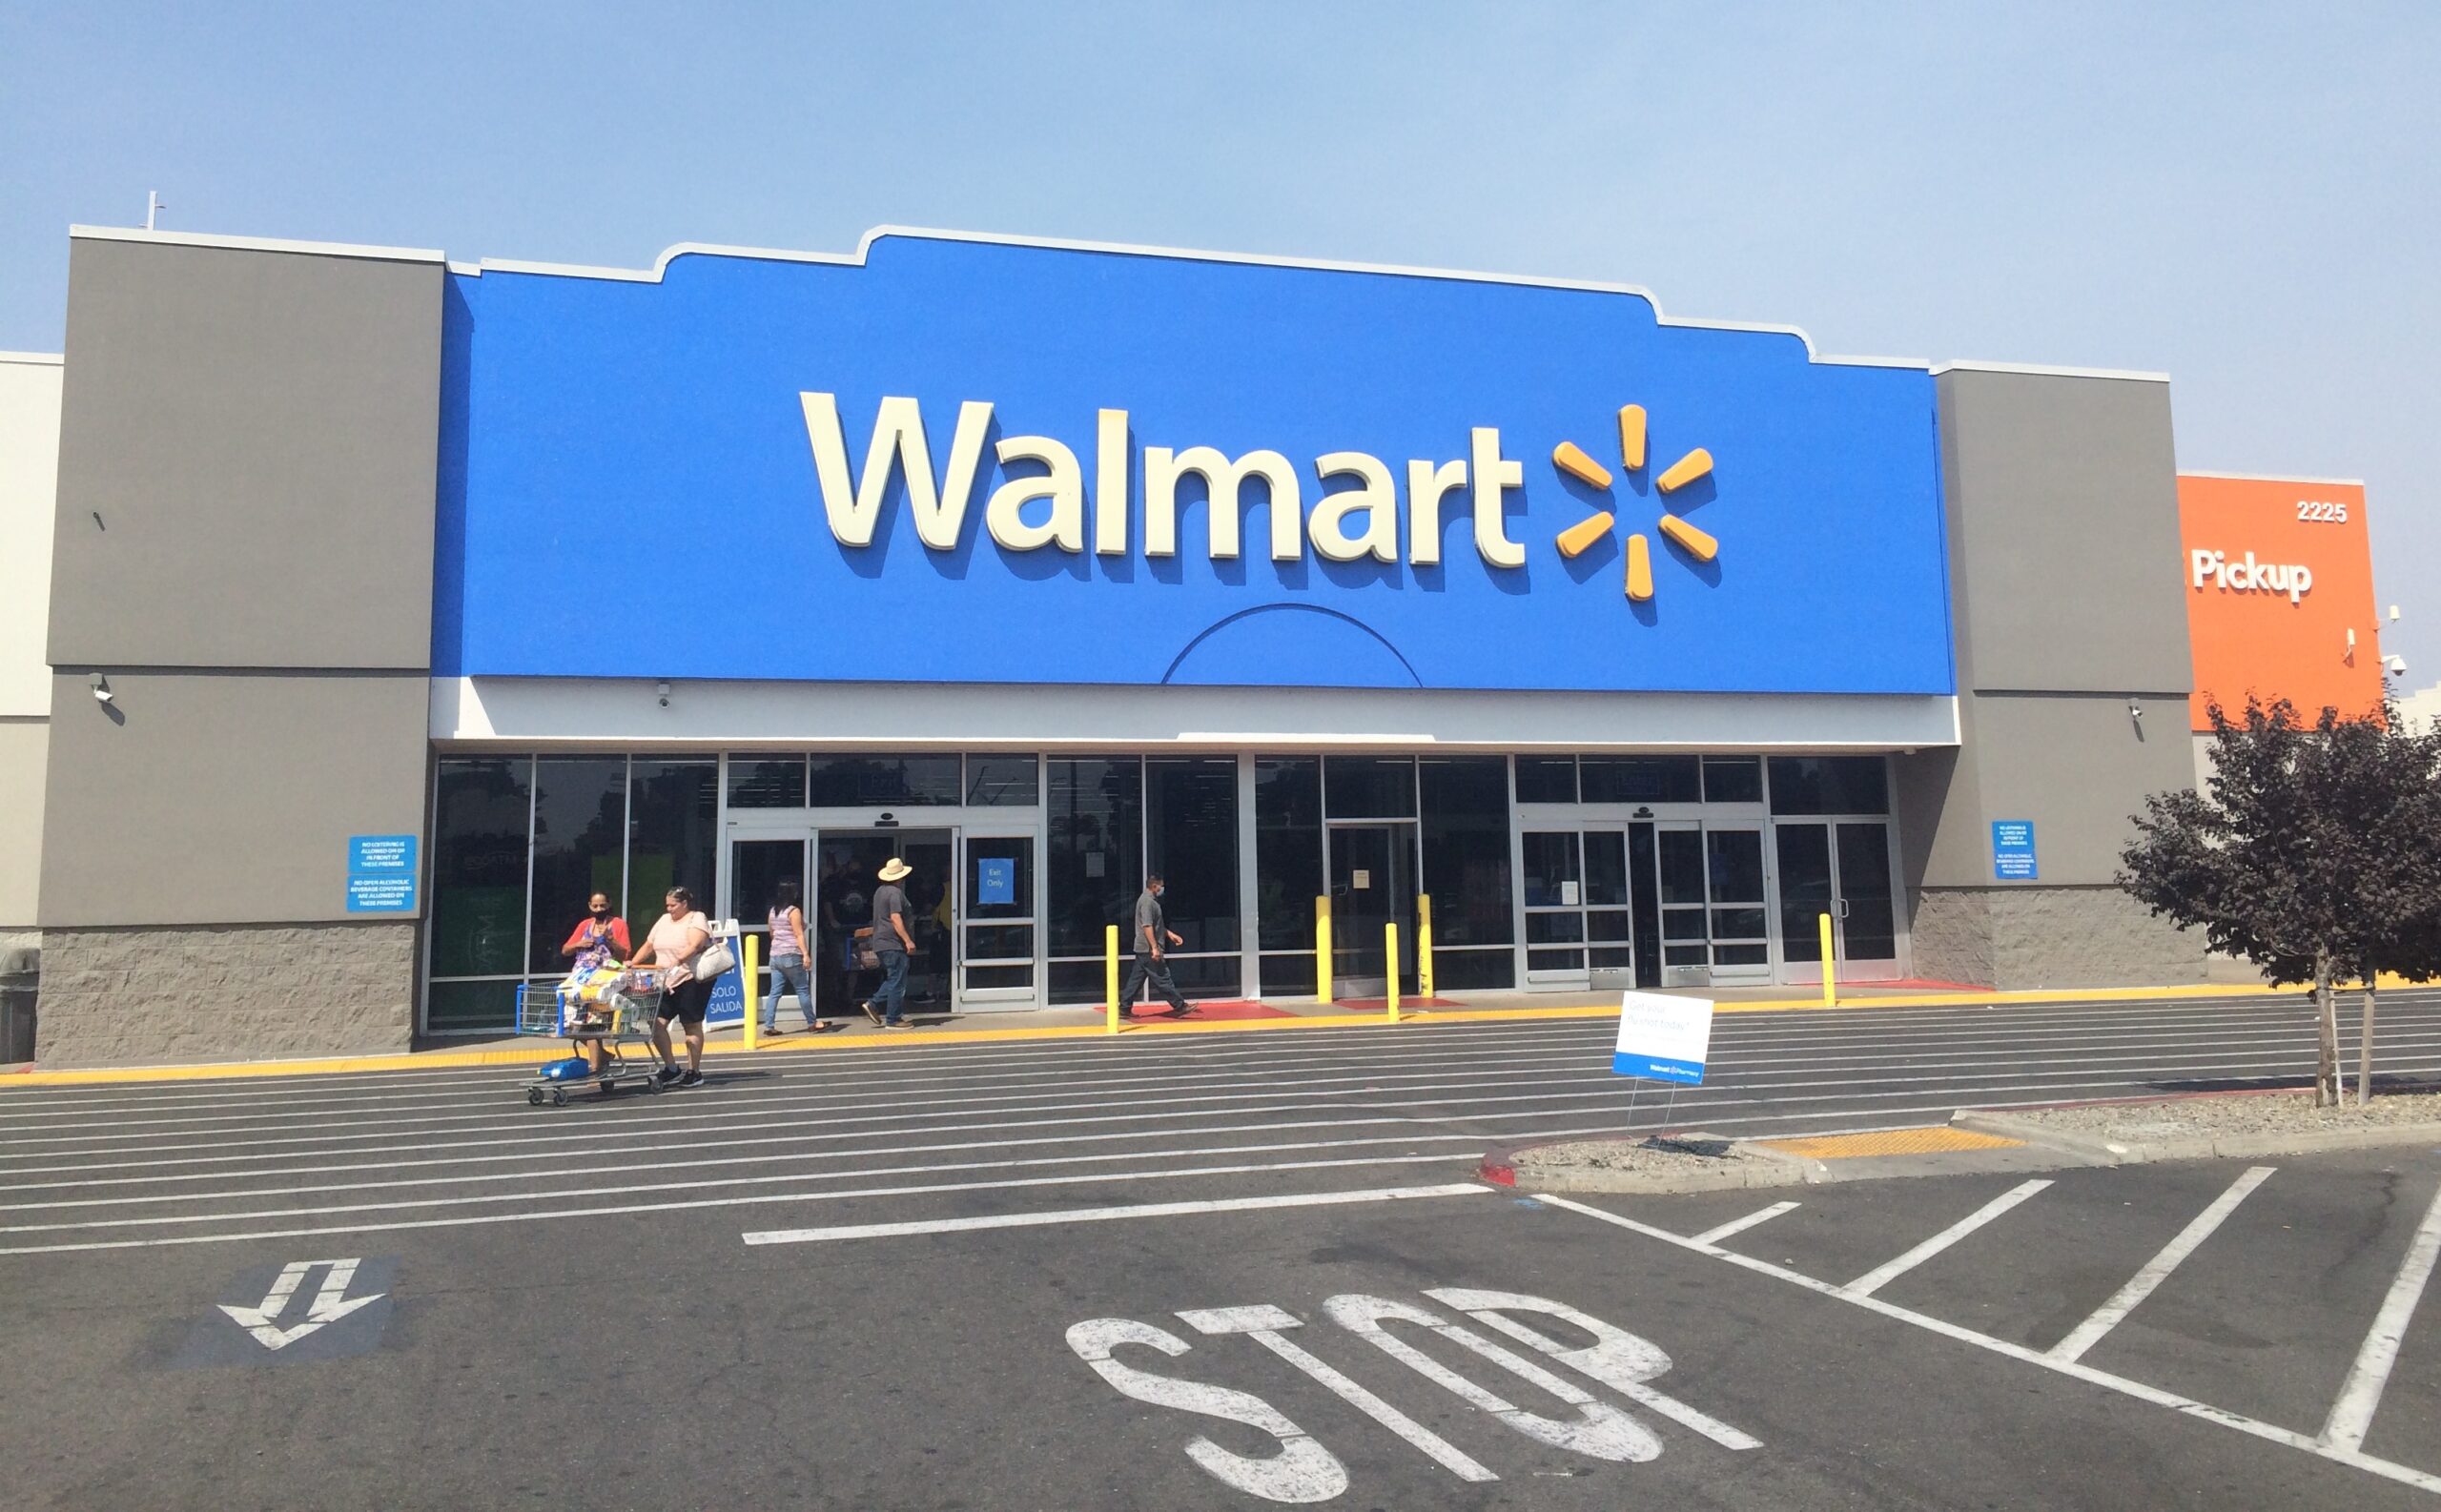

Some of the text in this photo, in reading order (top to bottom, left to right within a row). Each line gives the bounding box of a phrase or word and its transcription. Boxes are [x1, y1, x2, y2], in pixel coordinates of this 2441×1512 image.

[799, 391, 1526, 568] Walmart
[2296, 501, 2348, 523] 2225
[2191, 549, 2312, 603] Pickup
[987, 879, 1004, 888] Only
[711, 986, 736, 998] SOLO
[709, 1001, 743, 1014] SALIDA
[1065, 1287, 1764, 1503] STOP
